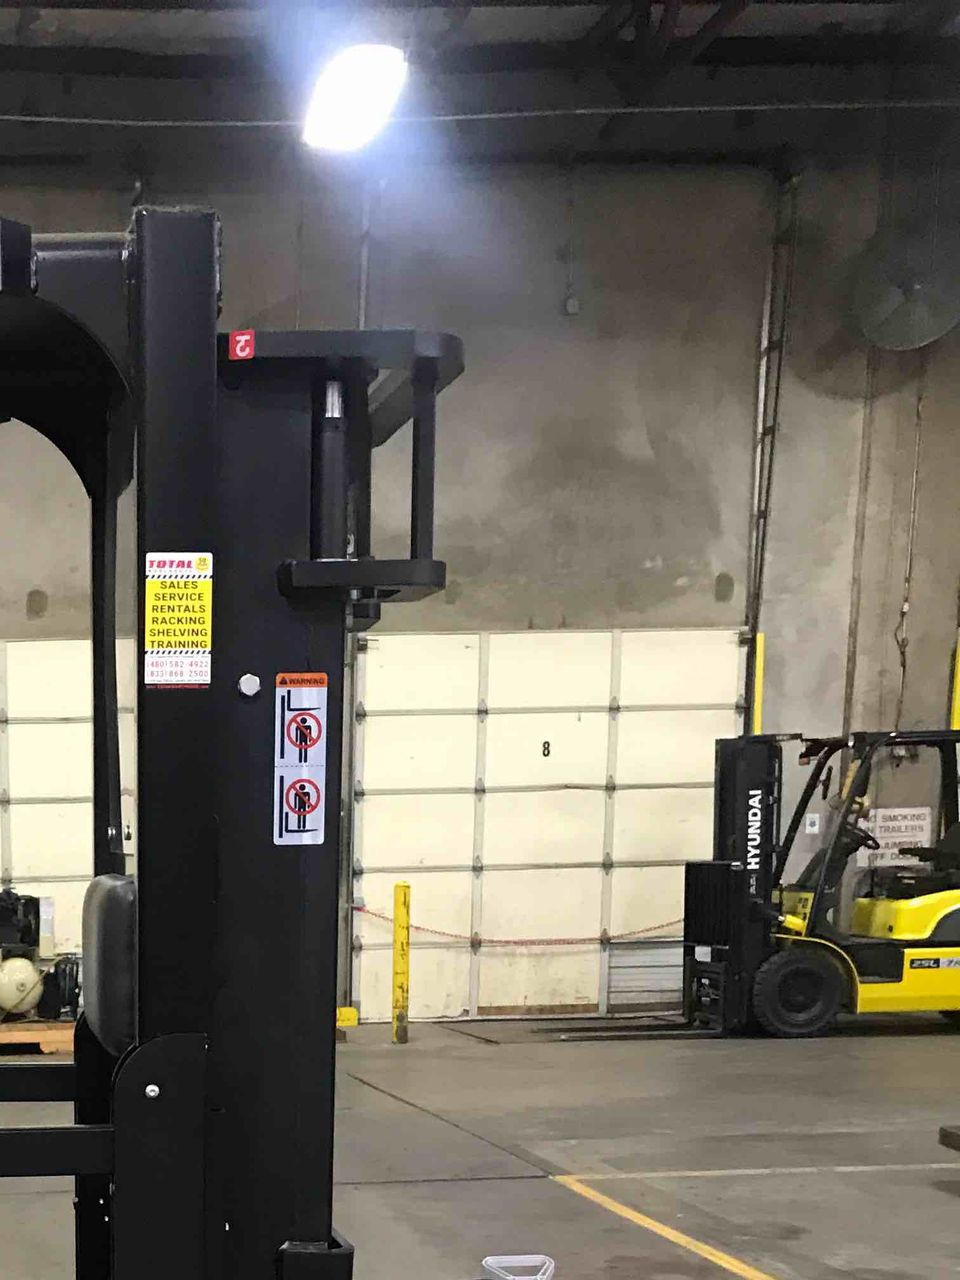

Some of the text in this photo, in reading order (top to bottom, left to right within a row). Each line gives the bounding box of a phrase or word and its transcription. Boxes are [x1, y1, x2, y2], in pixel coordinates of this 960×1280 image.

[148, 560, 193, 568] TOTAL
[160, 581, 198, 590] SALES
[154, 593, 204, 602] SERVICE
[151, 605, 206, 614] RENTALS
[152, 617, 206, 625] RACKING
[149, 629, 208, 637] SHELVING
[149, 640, 208, 649] TRAINING
[542, 741, 550, 757] 8
[881, 813, 927, 822] SMOKING
[747, 789, 762, 870] HYUNDAI
[879, 824, 924, 833] TRAILERS
